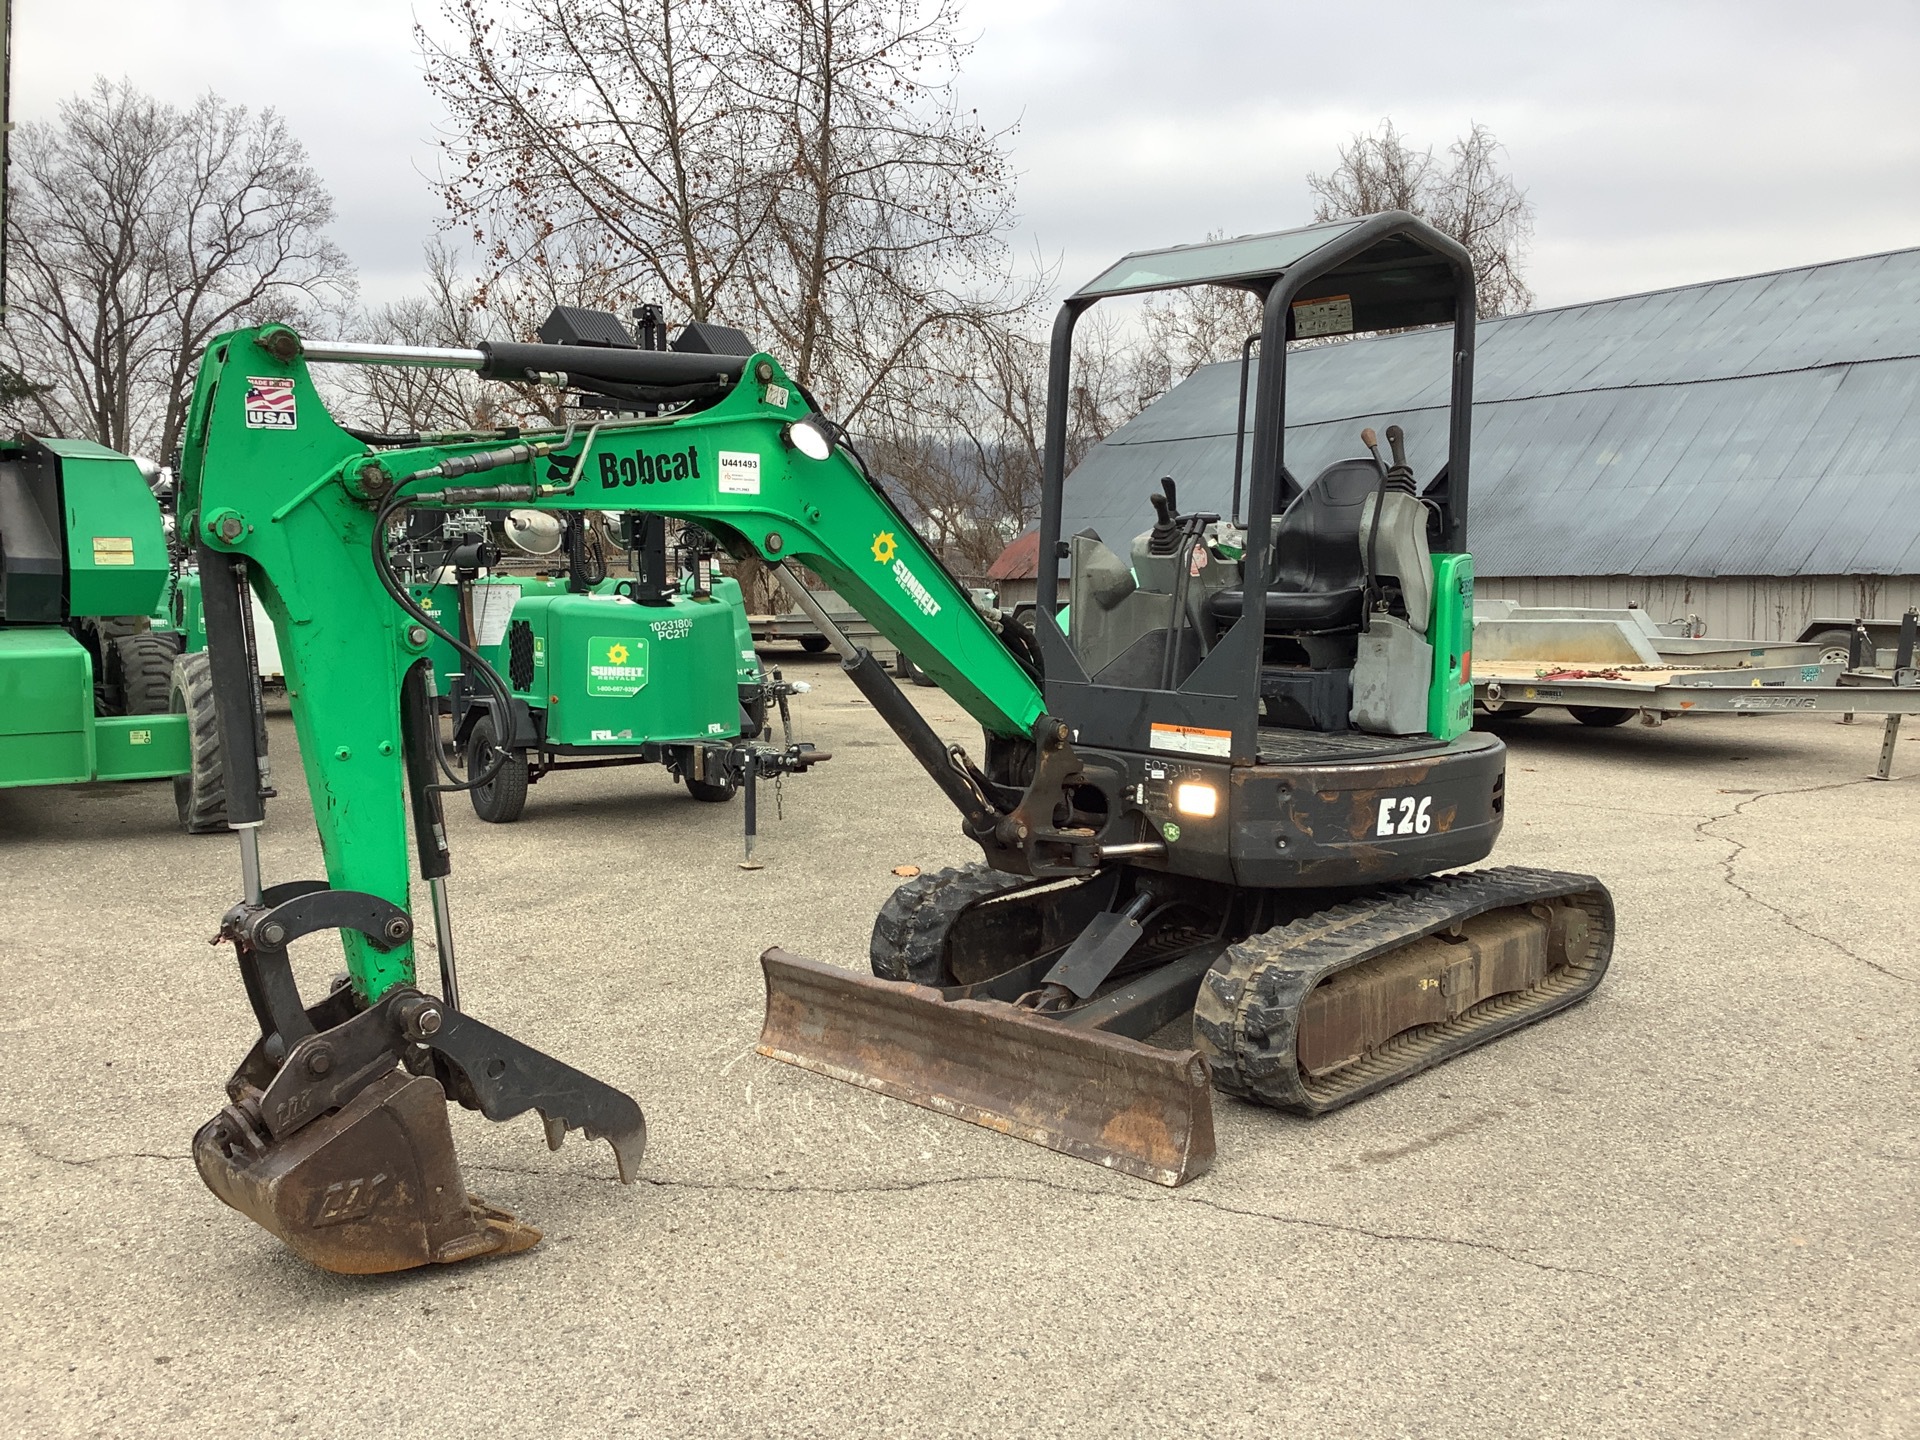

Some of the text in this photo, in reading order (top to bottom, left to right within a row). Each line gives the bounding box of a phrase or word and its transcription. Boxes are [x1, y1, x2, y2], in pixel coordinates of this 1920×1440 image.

[249, 411, 293, 424] USA
[598, 446, 700, 489] Bobcat
[721, 458, 758, 469] U441493
[892, 559, 942, 617] SUNBELT
[895, 575, 929, 616] RENTALS
[649, 618, 693, 632] 10231806
[657, 628, 689, 641] PC217
[591, 666, 644, 677] SUNBELT
[1376, 796, 1432, 837] E26
